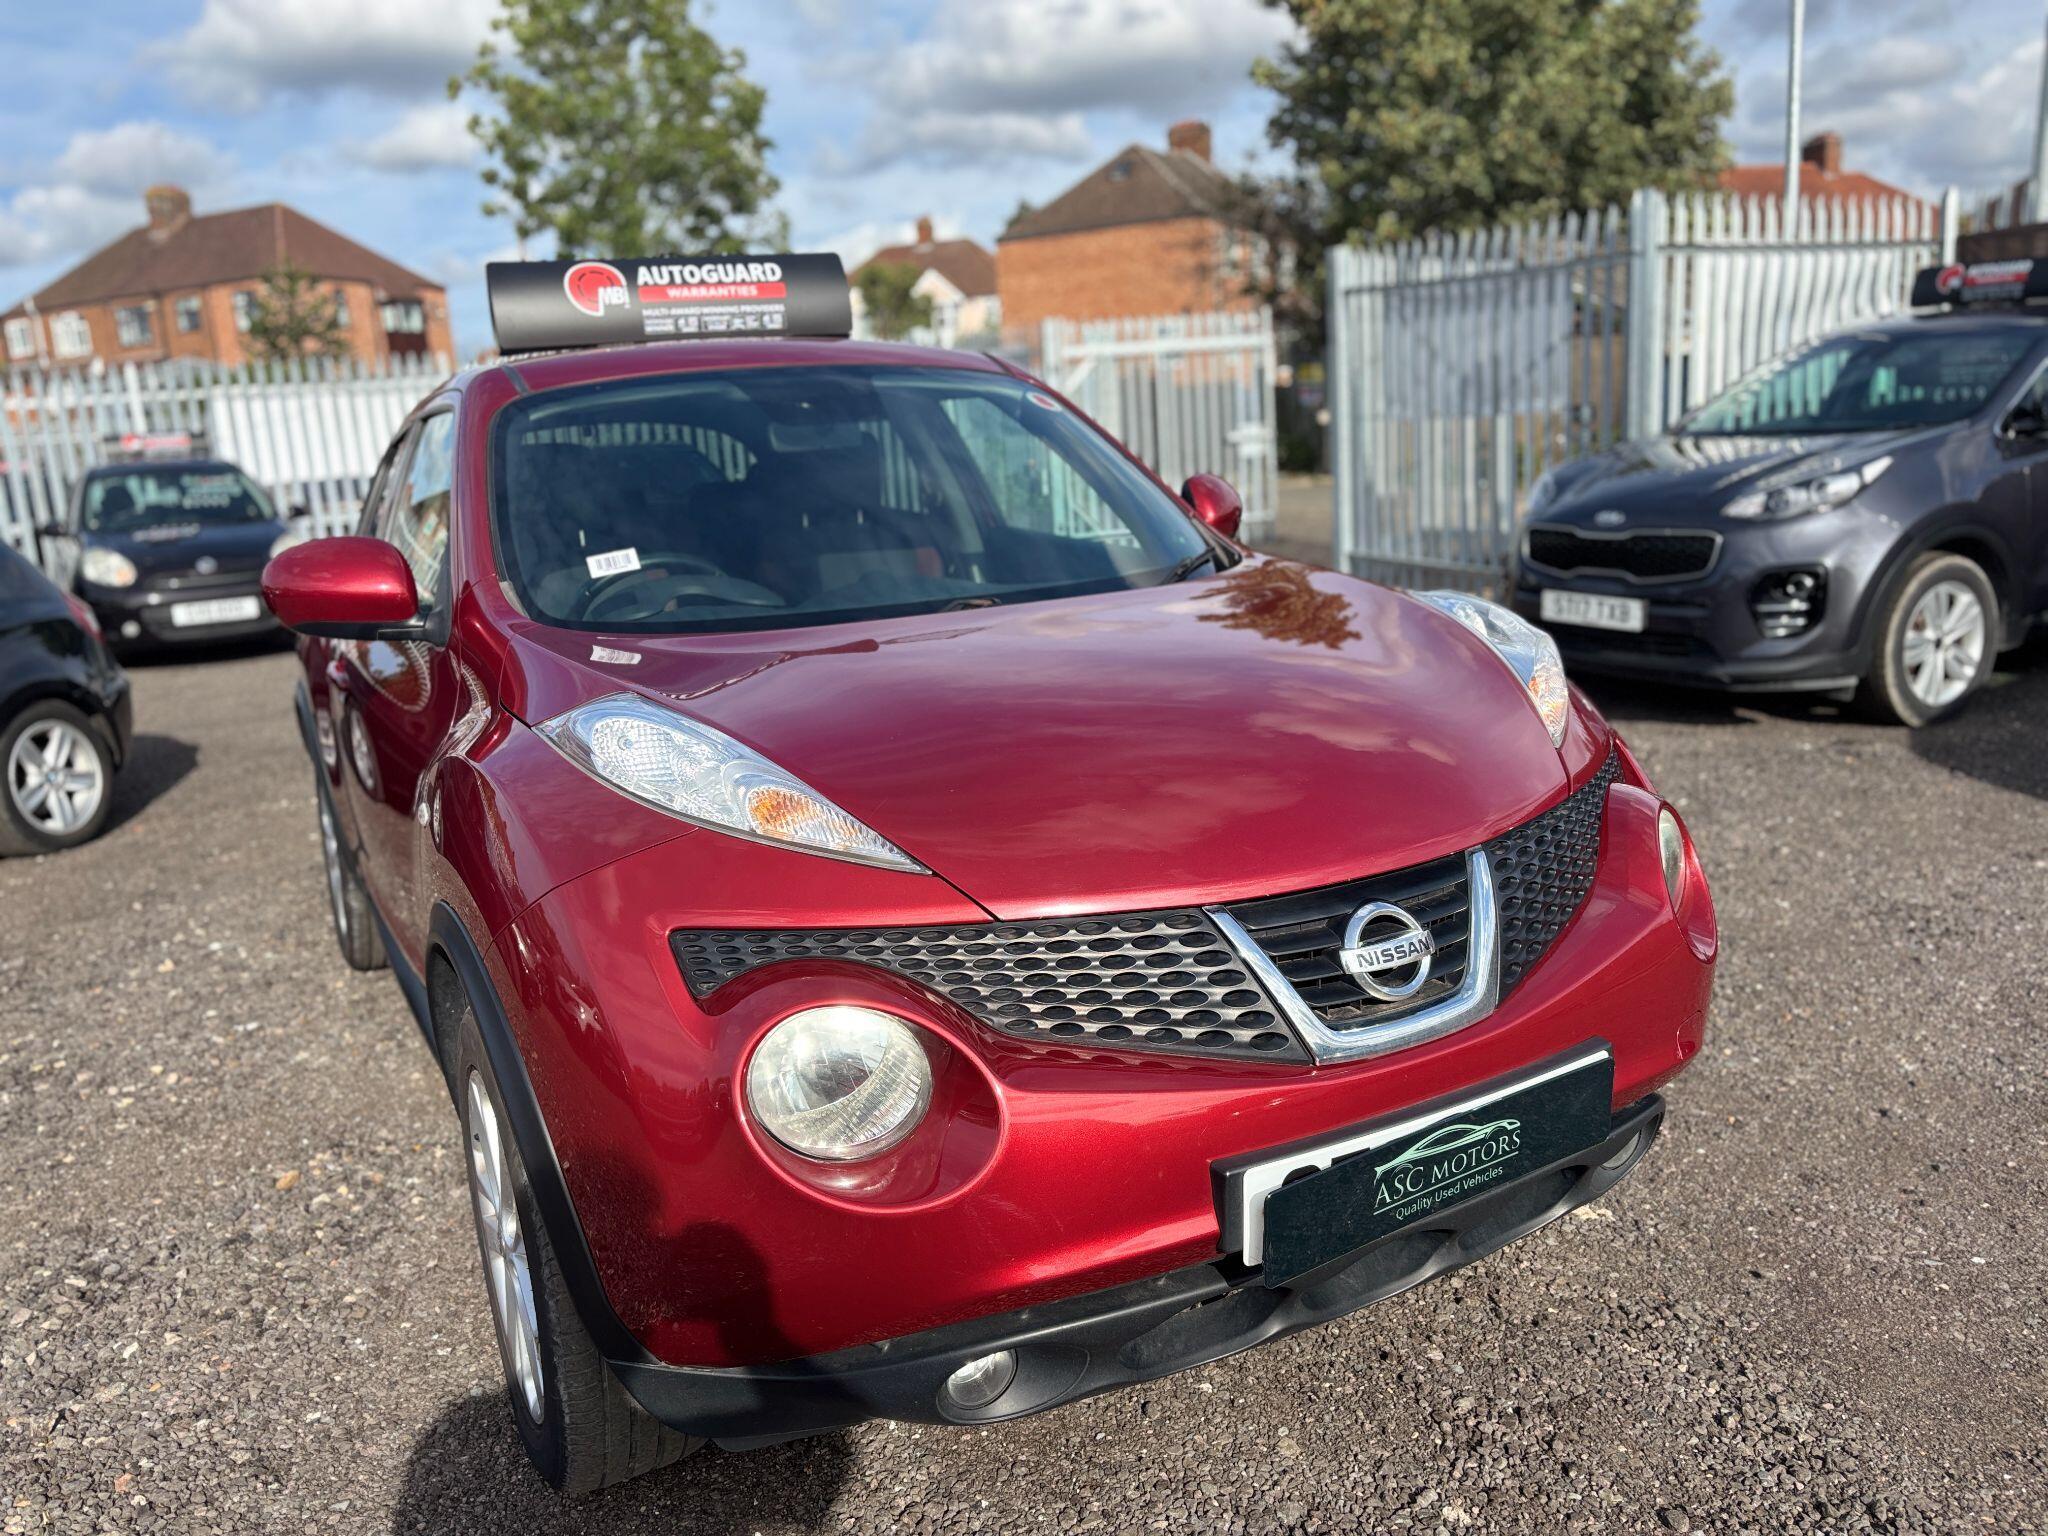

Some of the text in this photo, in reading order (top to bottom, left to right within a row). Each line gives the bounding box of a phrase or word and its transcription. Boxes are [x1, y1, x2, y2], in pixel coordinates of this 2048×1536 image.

[637, 262, 783, 286] AUTOGUARD
[666, 285, 758, 299] WARRANTIES
[1356, 936, 1432, 968] NISSAN
[1374, 1129, 1521, 1208] ASC MOTORS
[1395, 1165, 1504, 1220] Quality Used Vehicles
